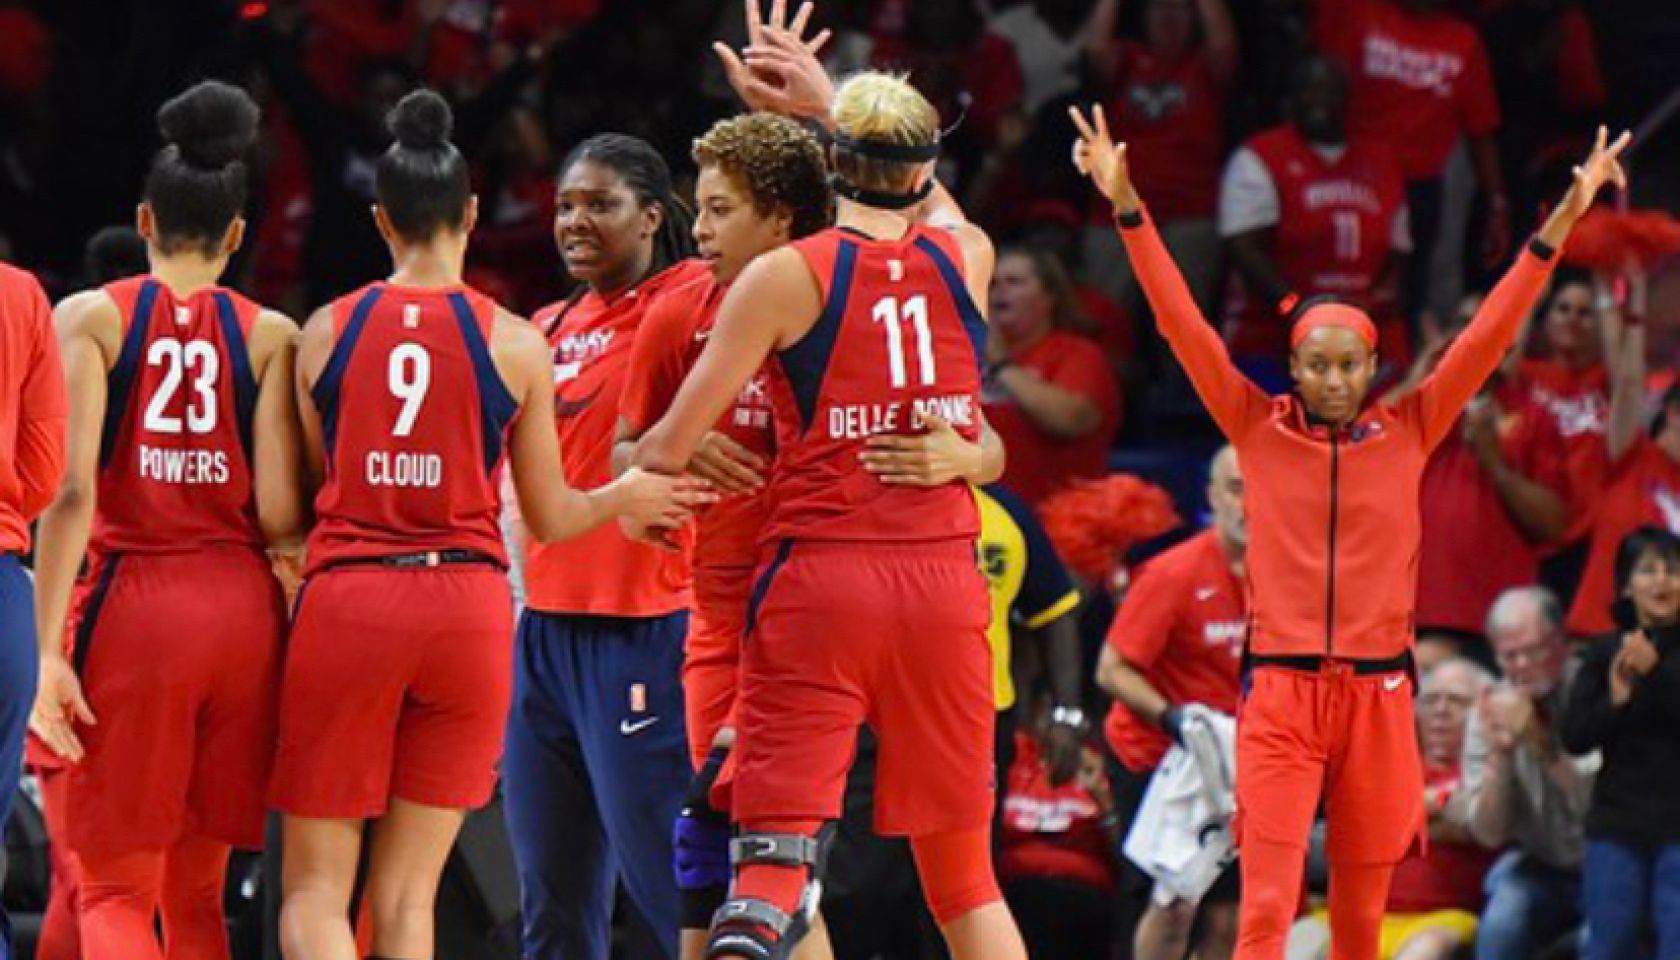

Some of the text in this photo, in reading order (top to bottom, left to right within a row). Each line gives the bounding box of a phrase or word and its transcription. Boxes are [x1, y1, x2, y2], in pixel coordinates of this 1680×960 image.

[872, 295, 936, 388] 11
[143, 338, 219, 434] 23
[388, 342, 430, 437] 9
[829, 402, 901, 440] DELLE
[139, 445, 229, 485] POWERS
[366, 451, 441, 488] CLOUD
